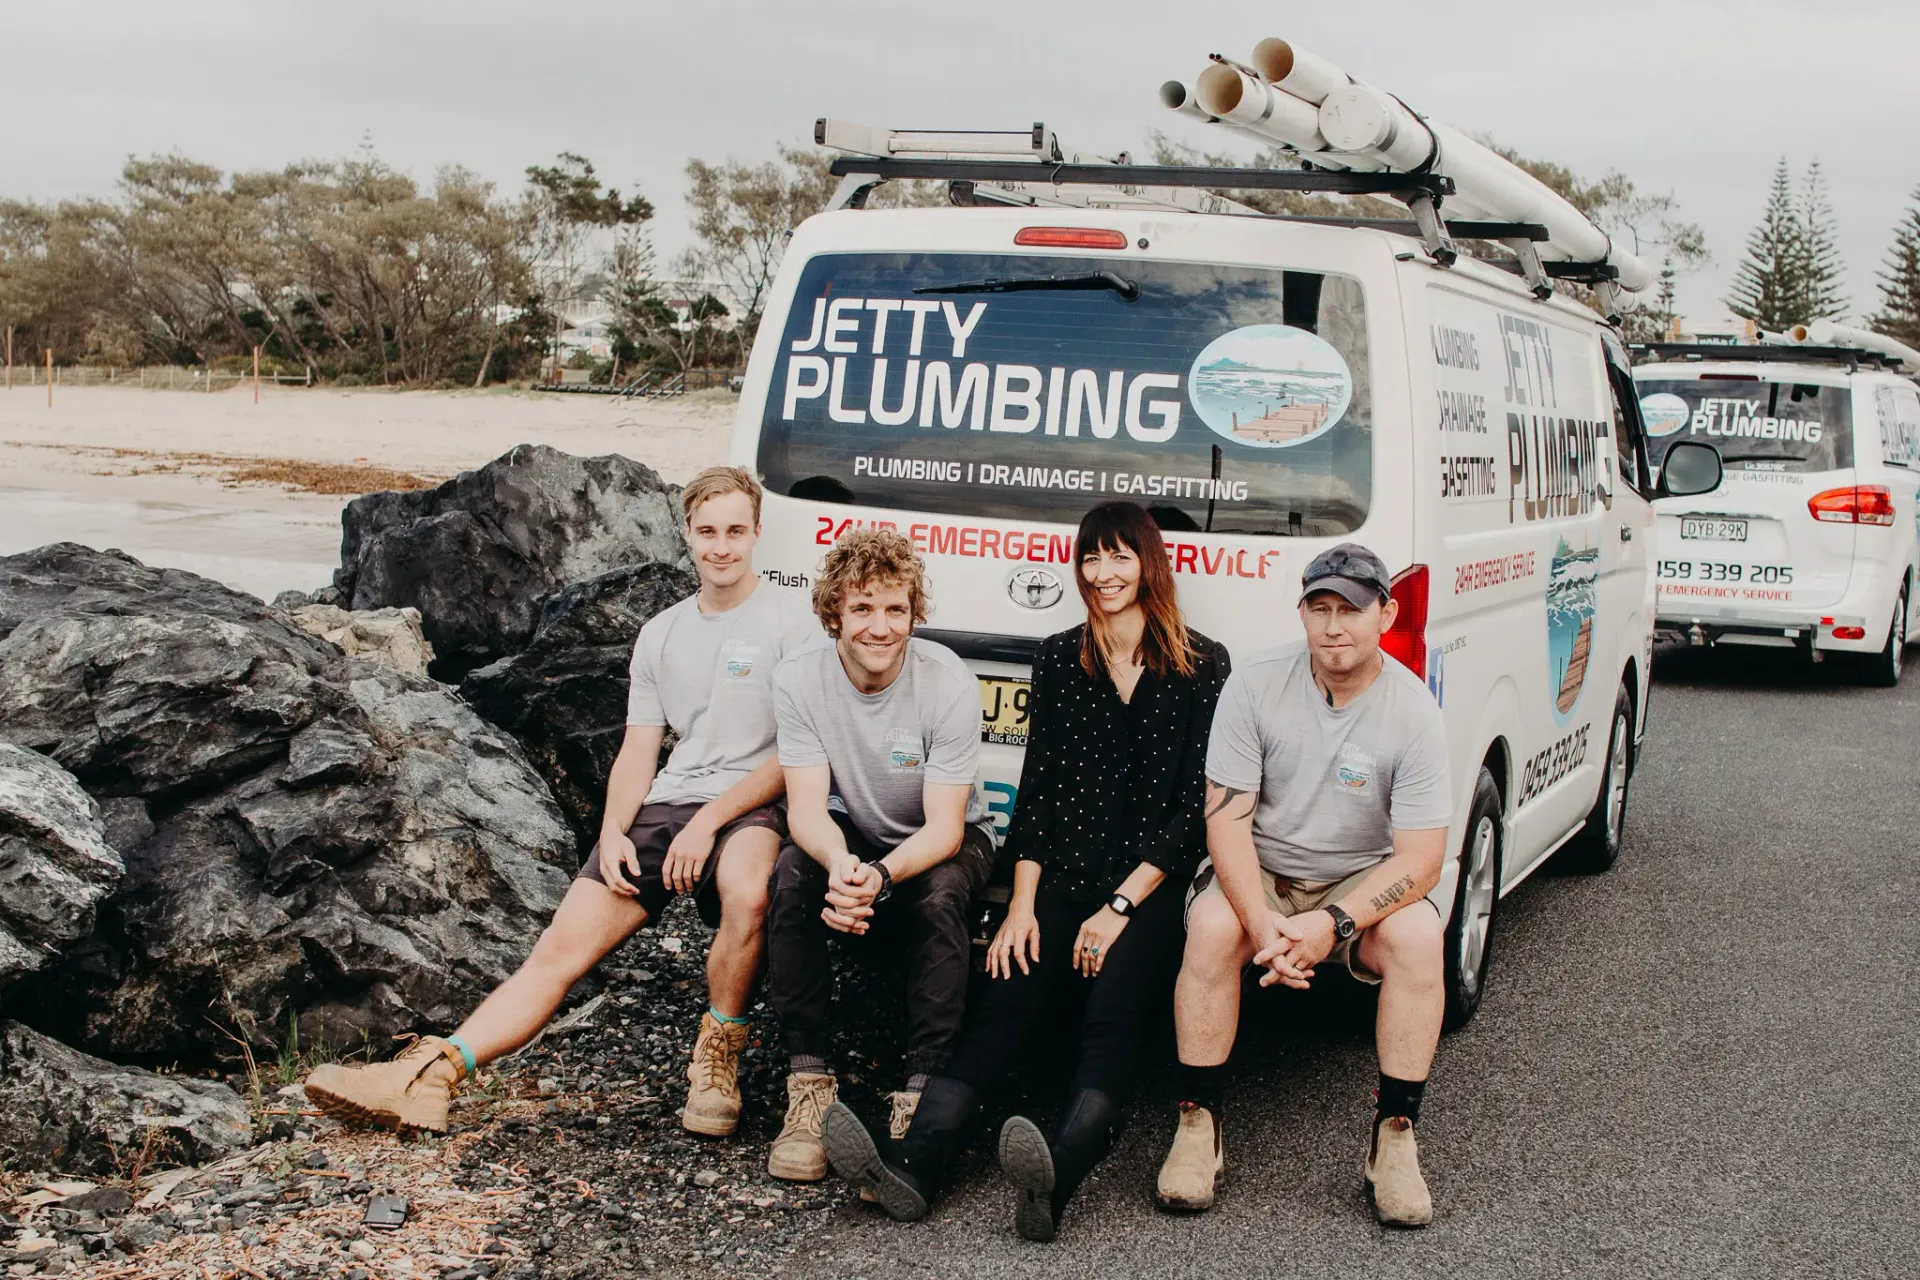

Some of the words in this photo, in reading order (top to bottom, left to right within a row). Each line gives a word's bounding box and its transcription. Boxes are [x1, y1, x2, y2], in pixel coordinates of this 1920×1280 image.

[791, 298, 988, 358] JETTY
[1496, 313, 1557, 408] JETTY
[782, 355, 1182, 443] PLUMBING
[1693, 398, 1761, 417] JETTY
[1690, 414, 1822, 443] PLUMBING
[854, 456, 961, 482] PLUMBING
[979, 463, 1095, 491] DRAINAGE
[1113, 472, 1248, 501] GASFITTING
[1440, 456, 1496, 497] GASFITTING
[1506, 412, 1613, 523] PLUMBING
[910, 523, 1072, 564] EMERGEN
[1474, 555, 1512, 590] EMERGENCY
[1512, 551, 1535, 580] SERVICE
[1699, 562, 1742, 581] 339
[1750, 565, 1794, 585] 205
[1666, 584, 1739, 598] EMERGENCY
[1743, 589, 1793, 601] SERVICE
[988, 733, 1004, 743] BIG
[1517, 746, 1552, 808] 0459
[1547, 733, 1572, 788] 339
[1567, 722, 1591, 774] 205
